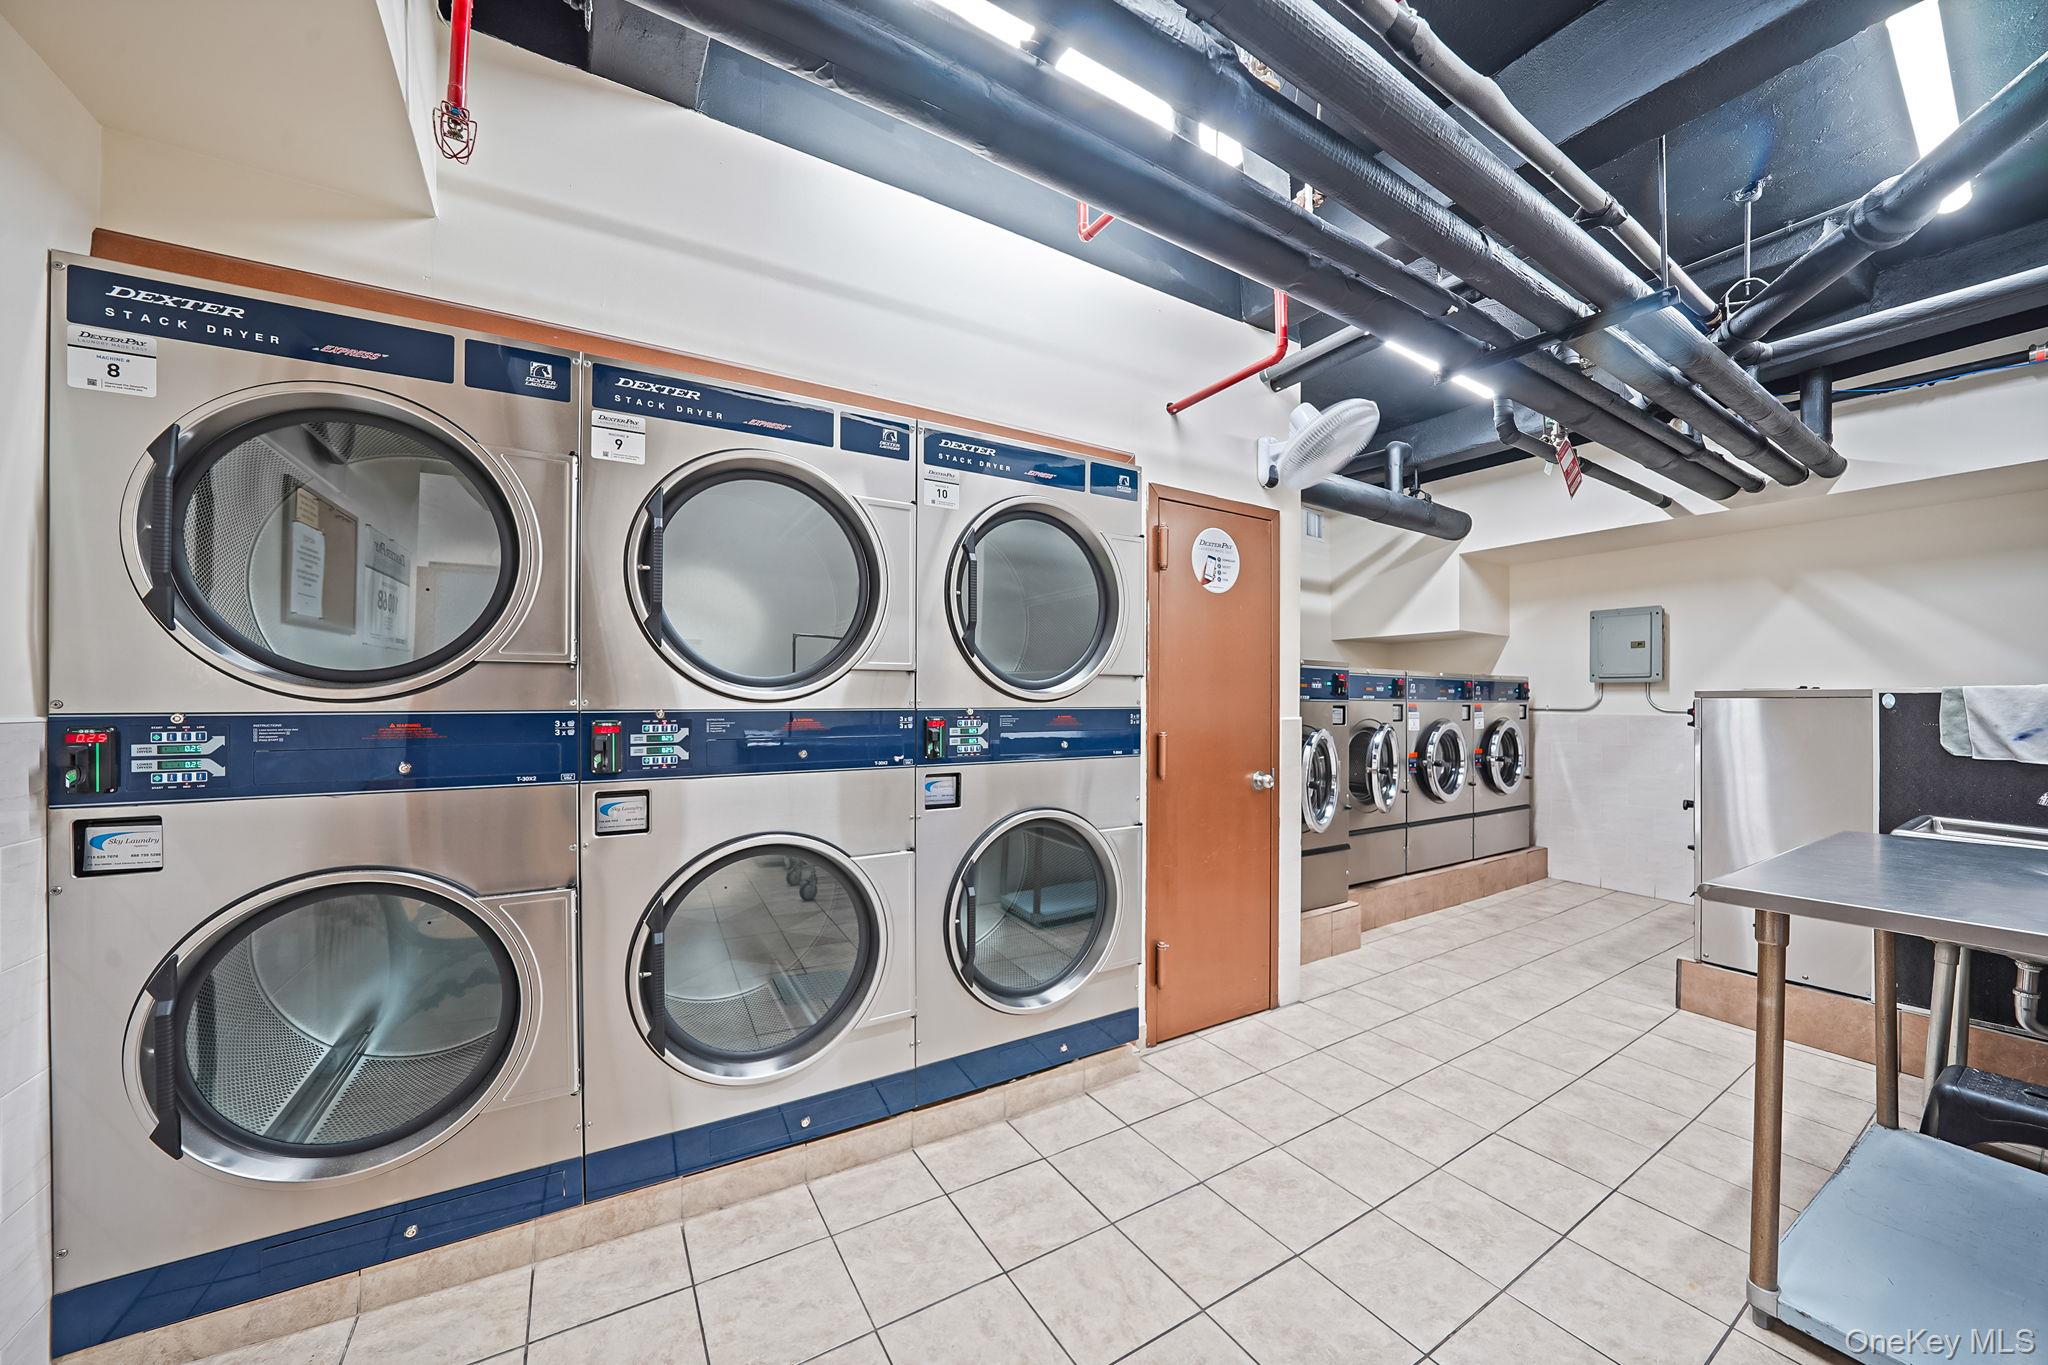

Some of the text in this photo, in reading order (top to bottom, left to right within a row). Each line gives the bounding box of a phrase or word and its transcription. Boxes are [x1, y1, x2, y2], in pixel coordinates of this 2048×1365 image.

[106, 285, 245, 319] DEXTER
[105, 307, 280, 345] STACK DRYER
[78, 338, 109, 347] LAUNDRY
[96, 354, 124, 363] MACHINE
[320, 345, 381, 360] EXPRESS
[107, 363, 120, 378] 8
[525, 376, 556, 386] DEXTER
[614, 377, 701, 401] DEXTER
[614, 394, 724, 420] STACK DRYER
[615, 439, 623, 450] 9
[939, 439, 996, 457] DEXTER
[938, 453, 1011, 472] STACK DRYER
[937, 488, 948, 499] 10
